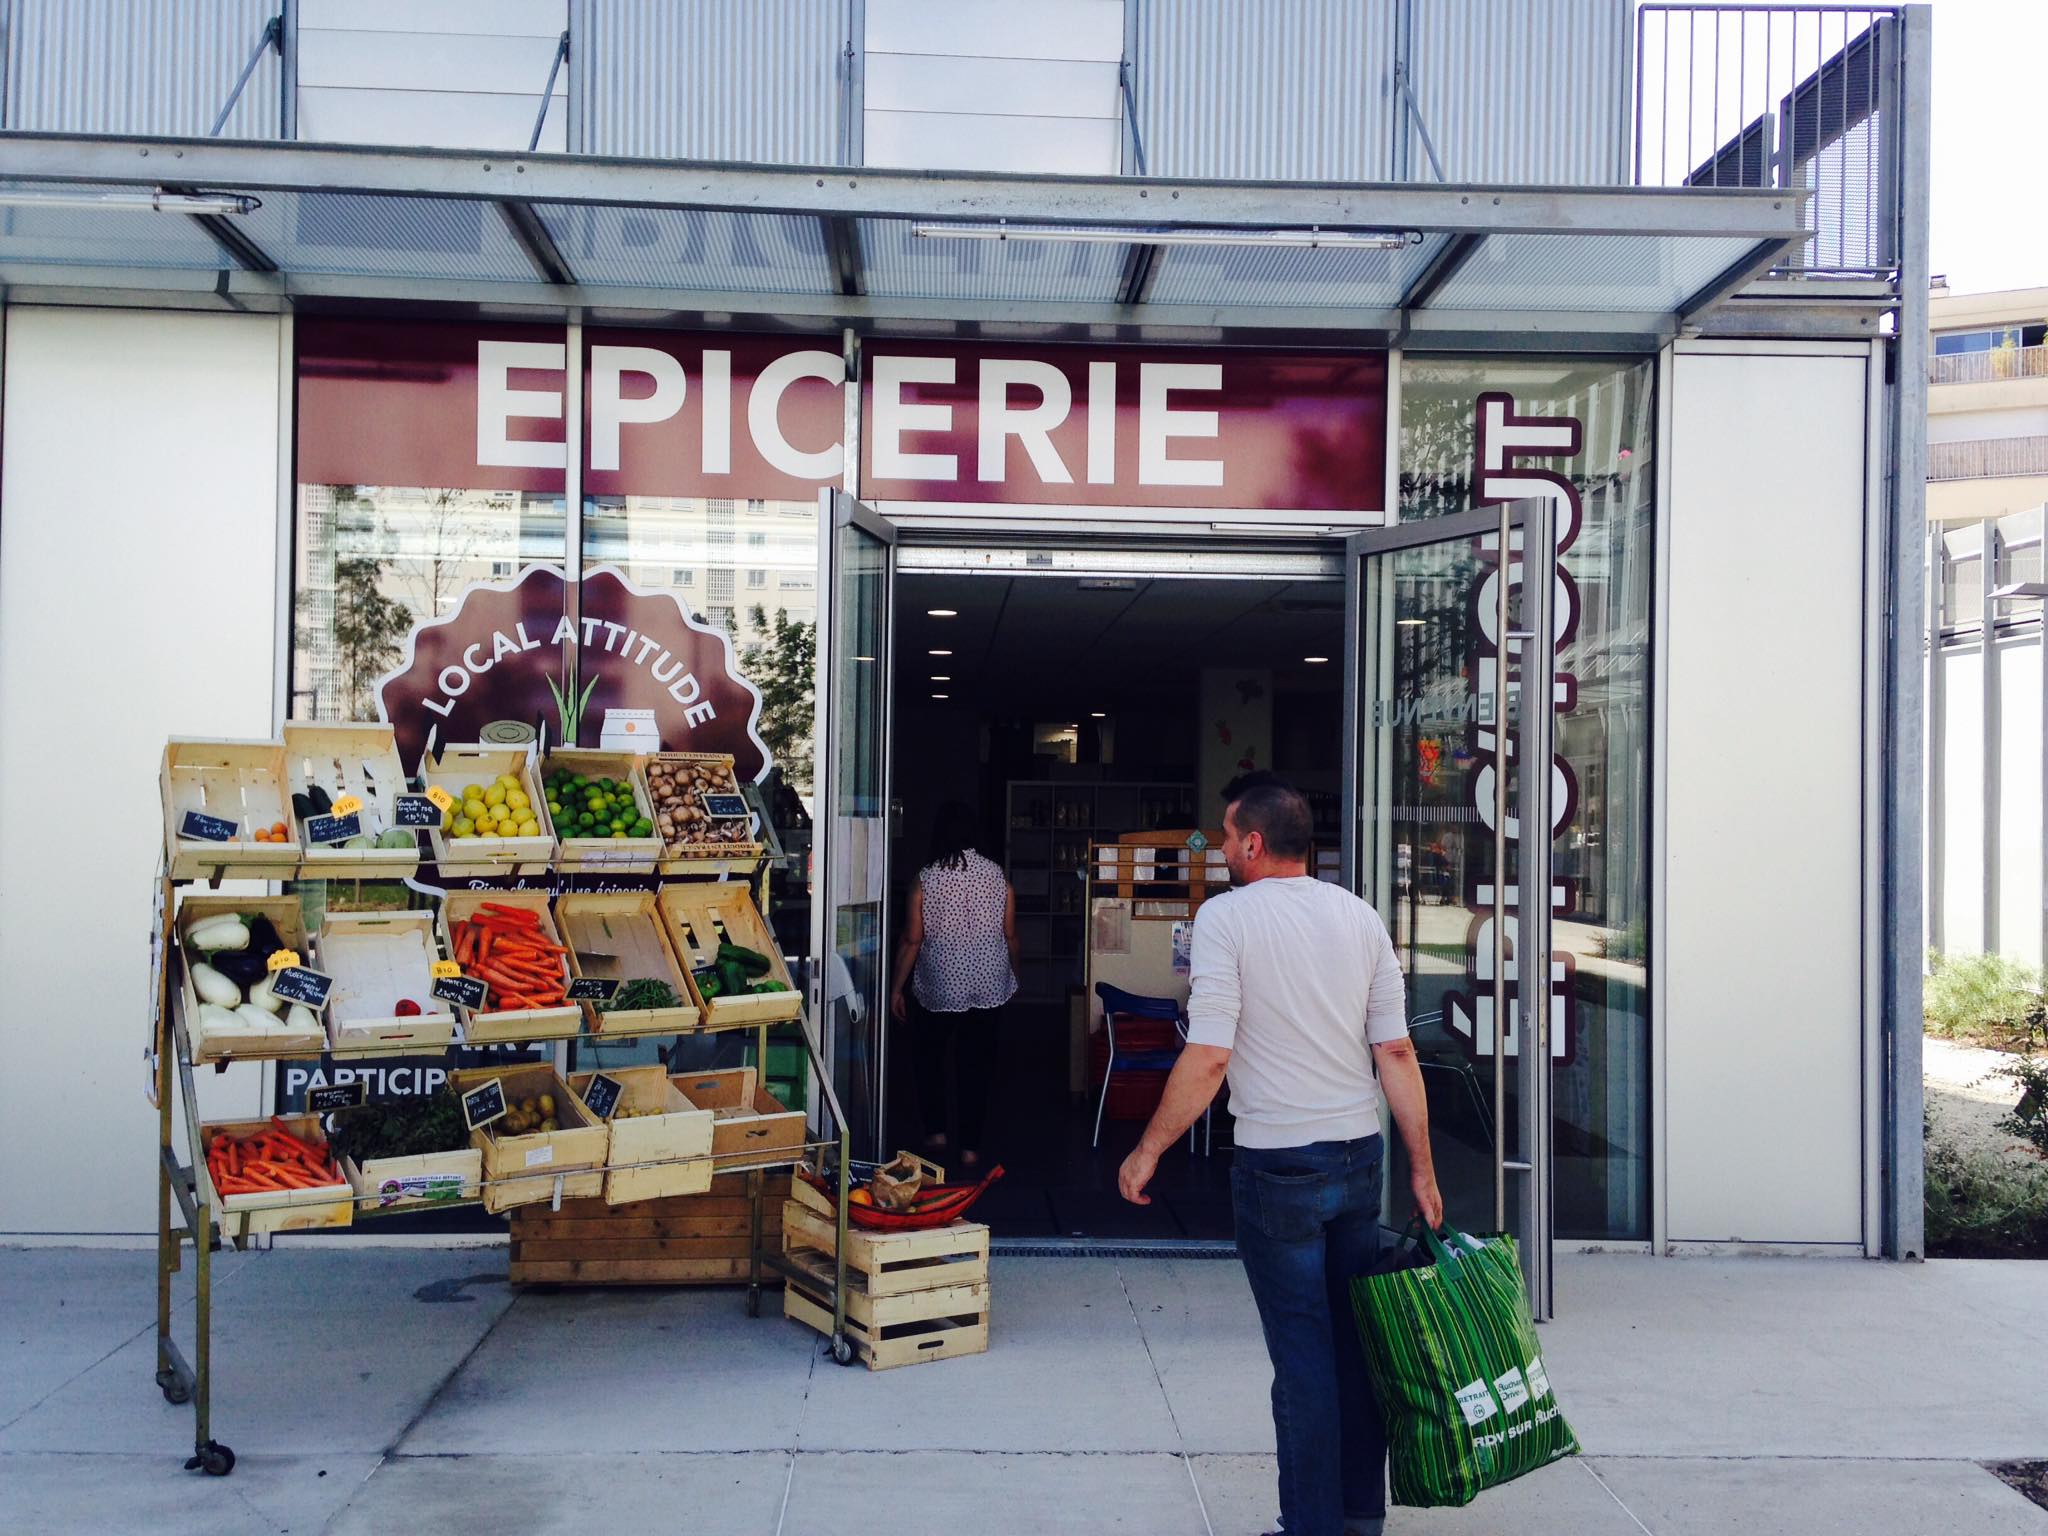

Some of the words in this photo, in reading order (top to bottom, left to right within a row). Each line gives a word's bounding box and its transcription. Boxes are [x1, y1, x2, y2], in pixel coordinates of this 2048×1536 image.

[477, 339, 1225, 487] EPICERIE
[421, 622, 541, 717] LOCAL
[551, 615, 718, 729] ATTITUDE
[286, 1068, 447, 1095] PARTICIP
[1458, 1390, 1489, 1404] RETRAIT
[1472, 1431, 1505, 1447] RDV
[1508, 1420, 1532, 1439] SUR
